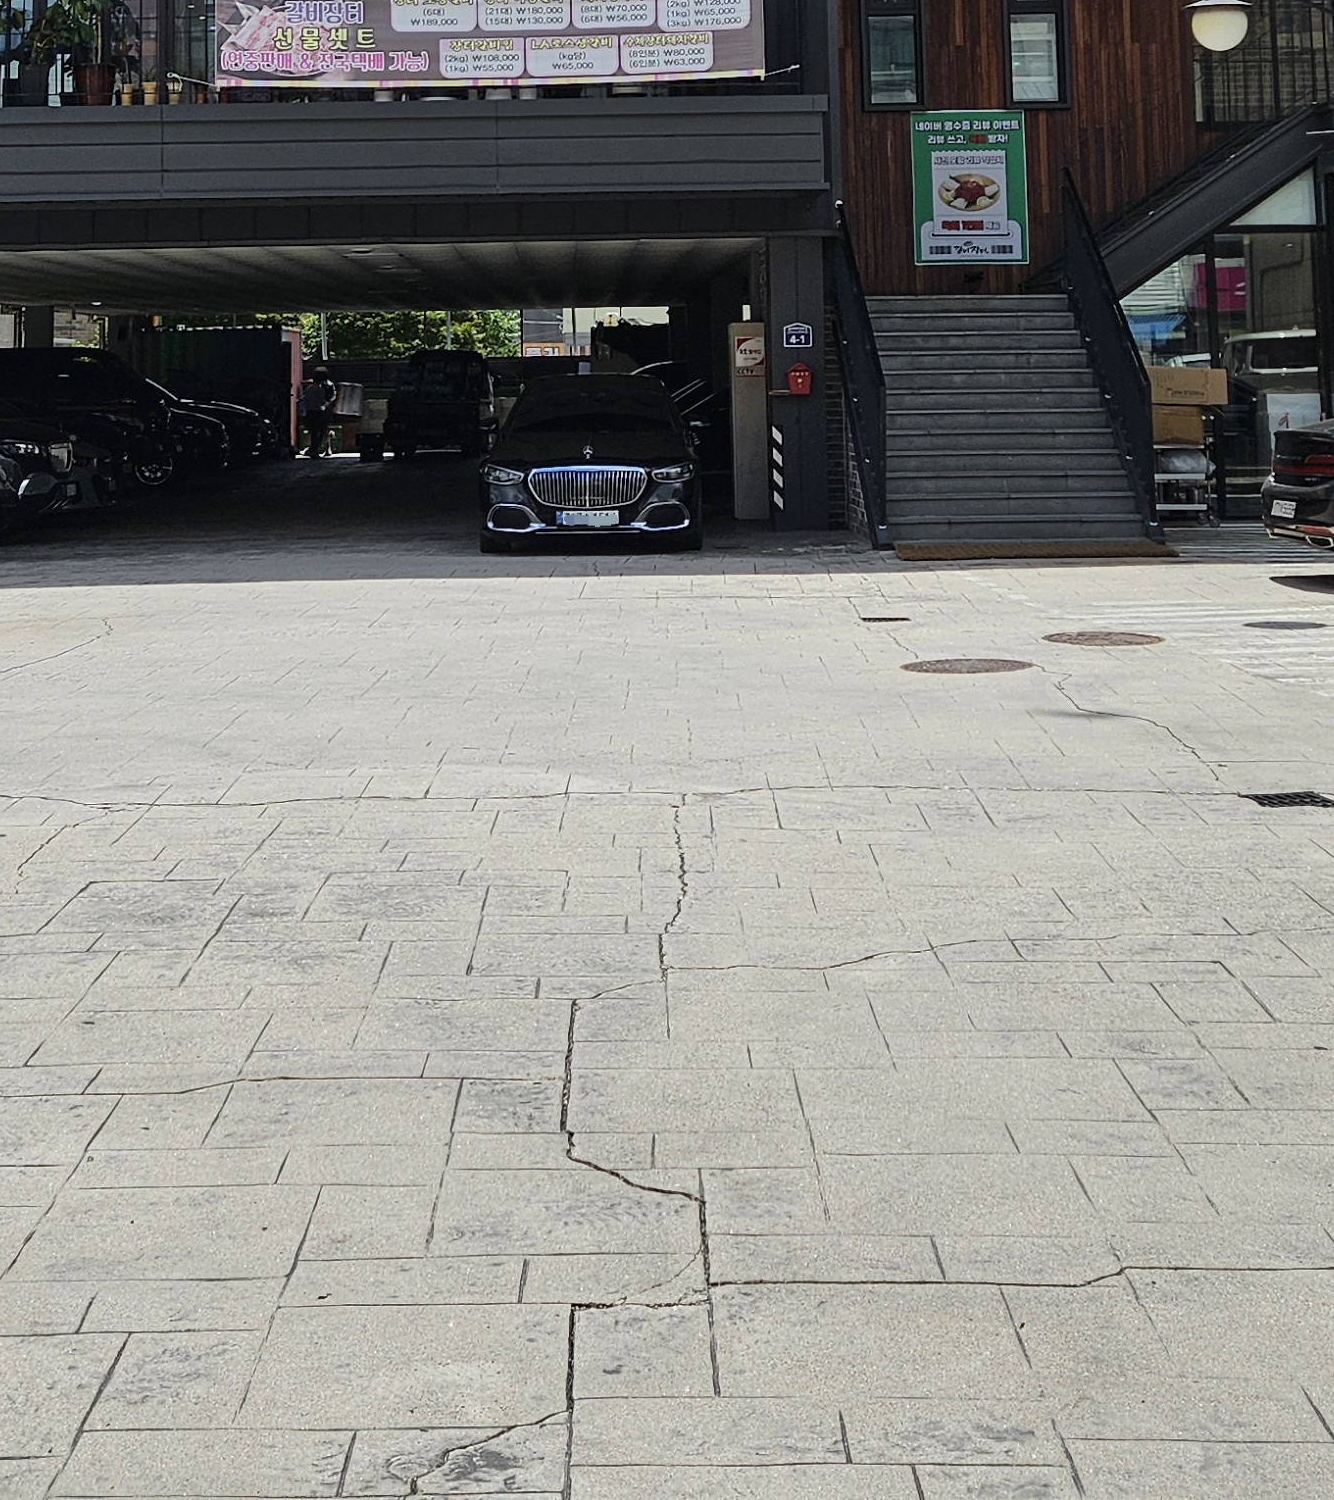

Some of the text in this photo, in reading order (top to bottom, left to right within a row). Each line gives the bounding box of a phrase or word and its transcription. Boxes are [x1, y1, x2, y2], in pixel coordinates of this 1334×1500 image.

[285, 1, 363, 25] 갈비장터
[423, 8, 445, 17] (6대)
[221, 51, 429, 71] (연중판매 & 전국택배 가능)
[915, 121, 942, 131] 네이버
[789, 334, 806, 344] 4-1
